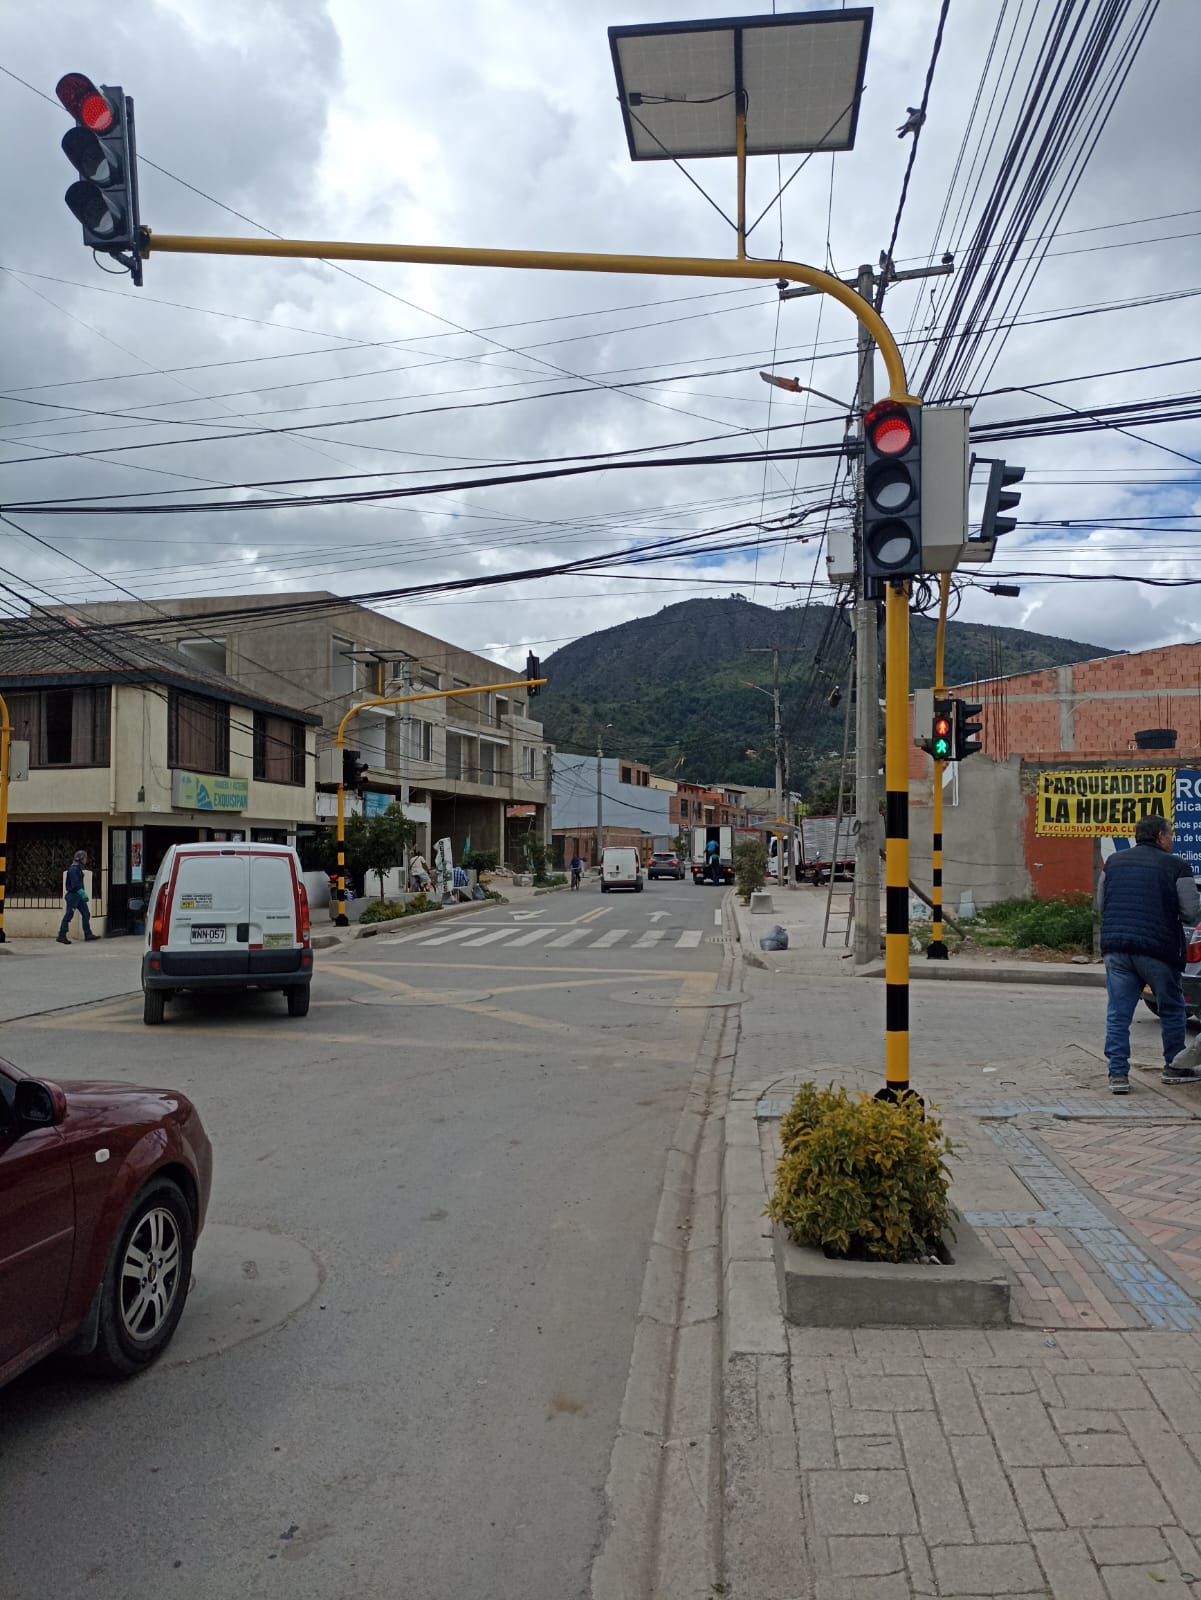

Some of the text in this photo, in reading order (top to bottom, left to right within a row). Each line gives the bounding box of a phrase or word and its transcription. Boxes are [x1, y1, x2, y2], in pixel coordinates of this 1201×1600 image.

[1044, 773, 1166, 797] PARQUEADERO
[1045, 797, 1165, 823] LA HUERTA
[1095, 825, 1118, 833] PARA
[1183, 833, 1193, 842] de
